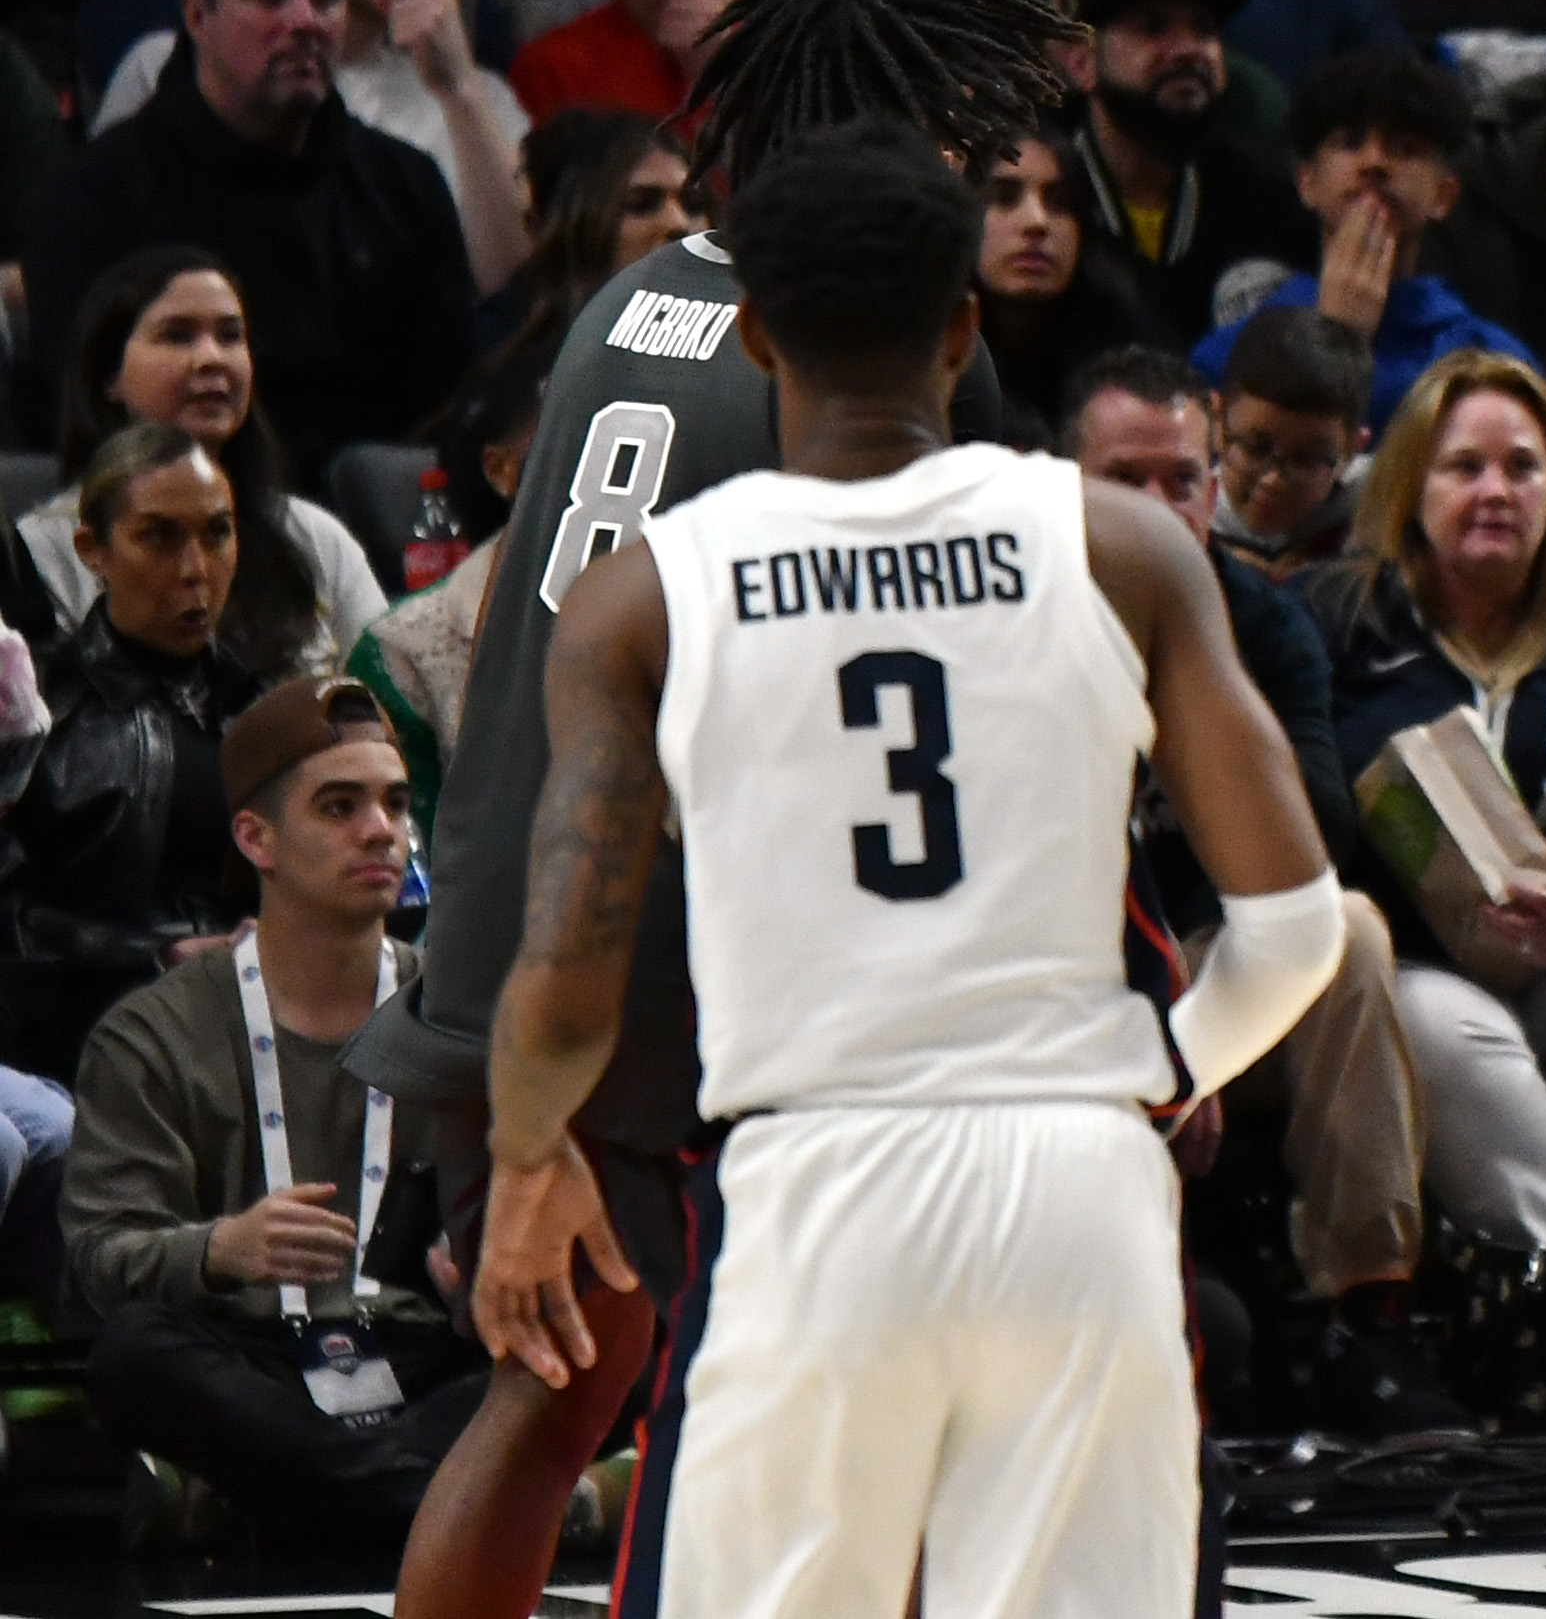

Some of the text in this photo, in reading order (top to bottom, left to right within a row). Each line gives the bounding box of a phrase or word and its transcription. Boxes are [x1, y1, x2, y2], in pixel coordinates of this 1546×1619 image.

[604, 288, 740, 362] MGBAKO
[538, 400, 676, 615] 8
[731, 531, 1026, 624] EDWARDS
[836, 649, 968, 903] 3
